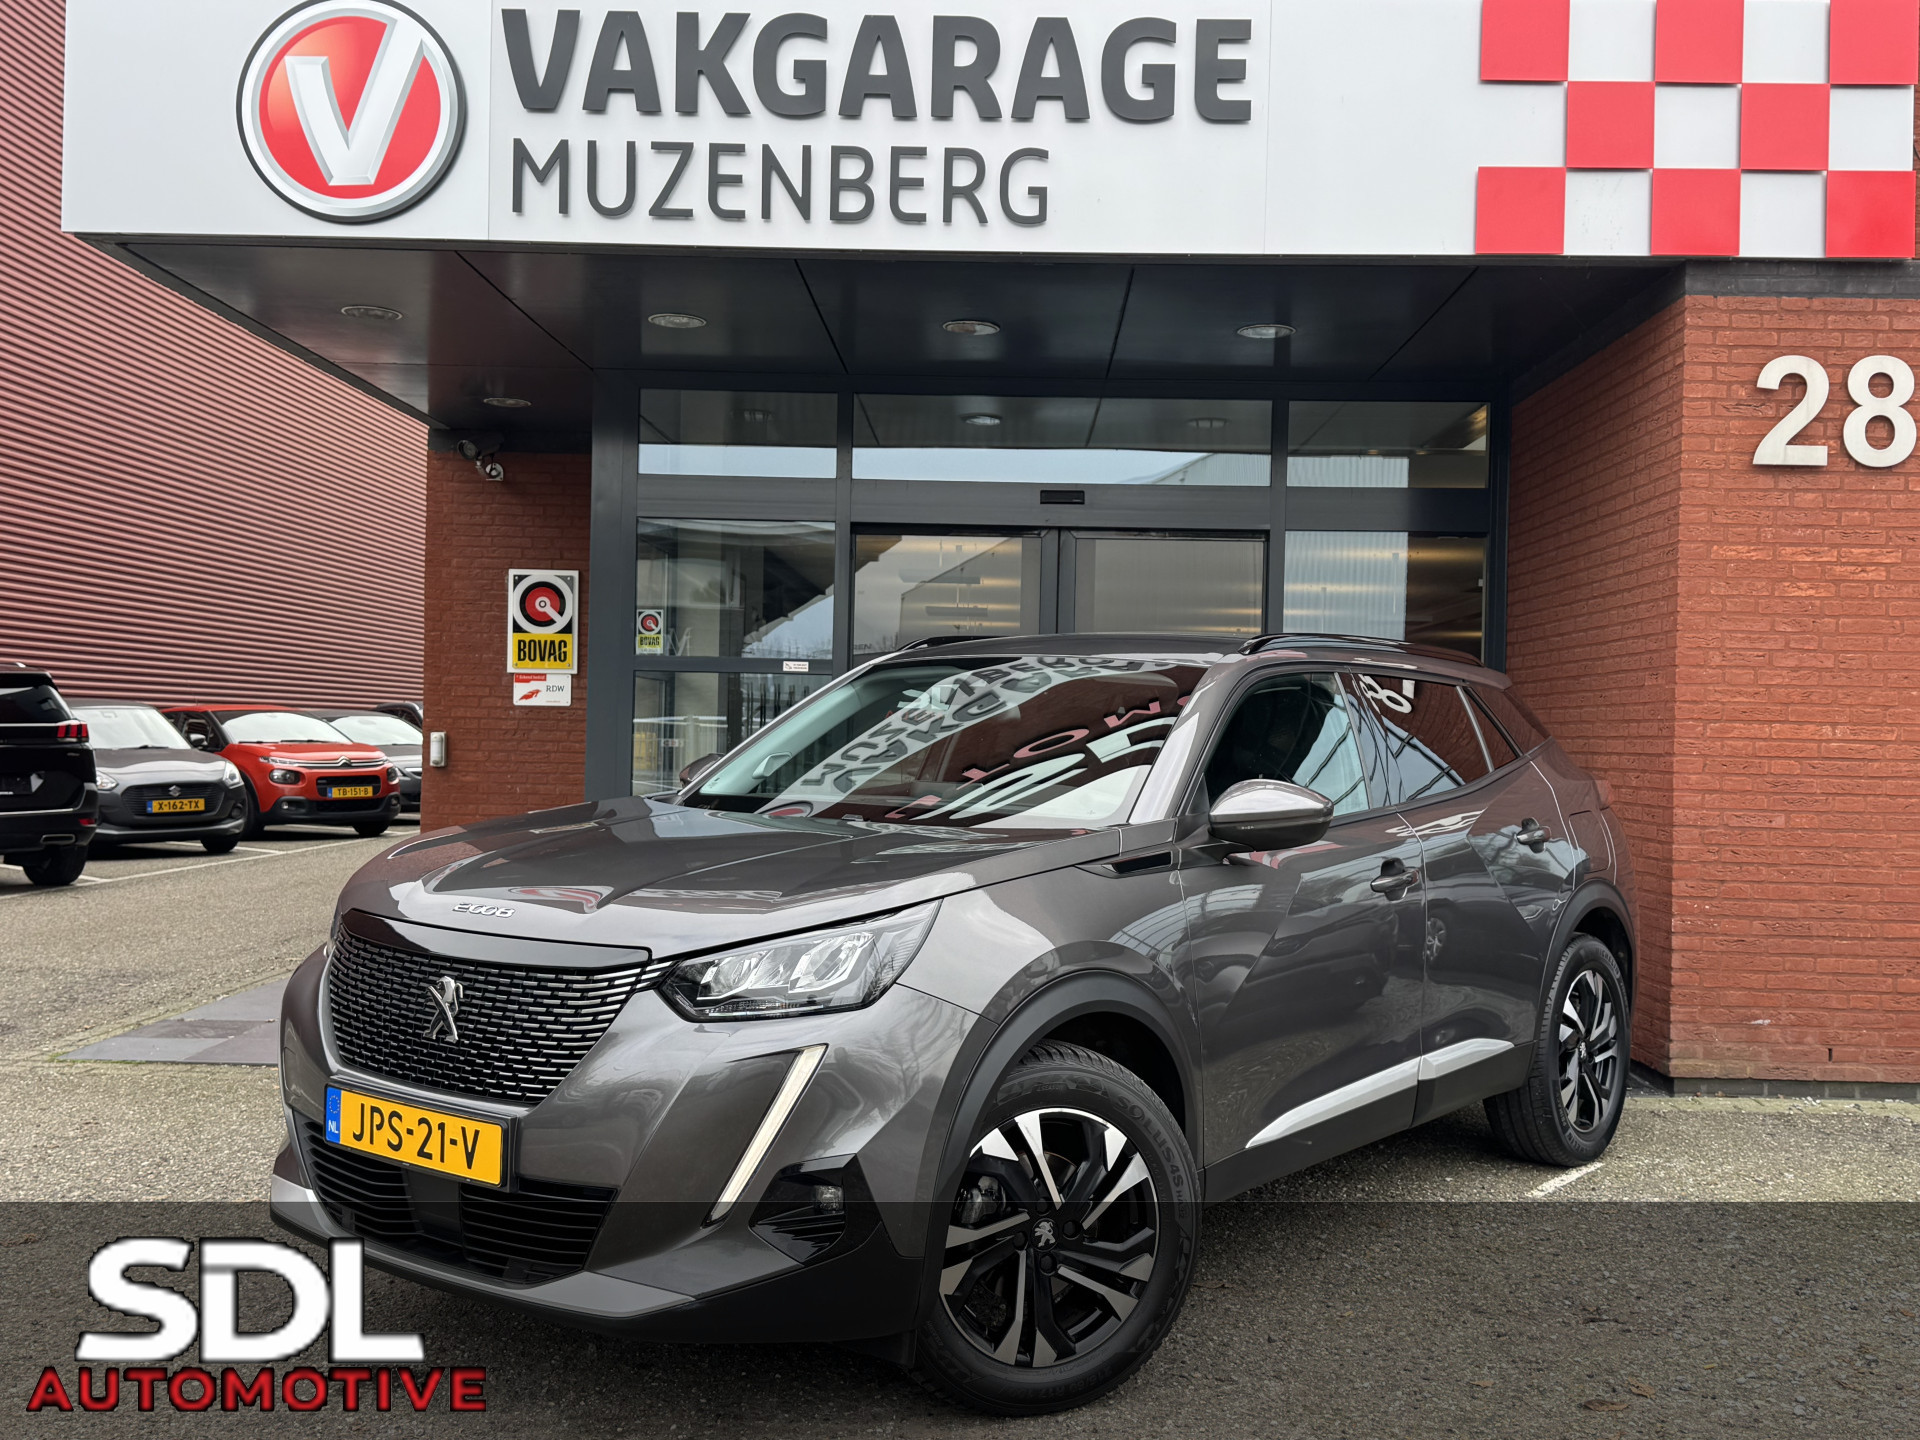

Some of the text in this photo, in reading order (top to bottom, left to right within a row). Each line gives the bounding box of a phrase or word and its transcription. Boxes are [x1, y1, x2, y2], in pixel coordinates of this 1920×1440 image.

[500, 8, 1253, 124] VAKGARAGE
[283, 18, 426, 187] V
[510, 137, 1050, 226] MUZENBERG
[1752, 354, 1917, 468] 28
[517, 639, 568, 662] BOVAG
[639, 636, 660, 646] BOVAG
[545, 685, 565, 693] RDW
[337, 787, 369, 796] TB-151-B
[157, 800, 200, 811] X-162-TX
[452, 902, 516, 919] 2008
[328, 1120, 339, 1134] NL
[352, 1102, 480, 1170] JPS-21-V
